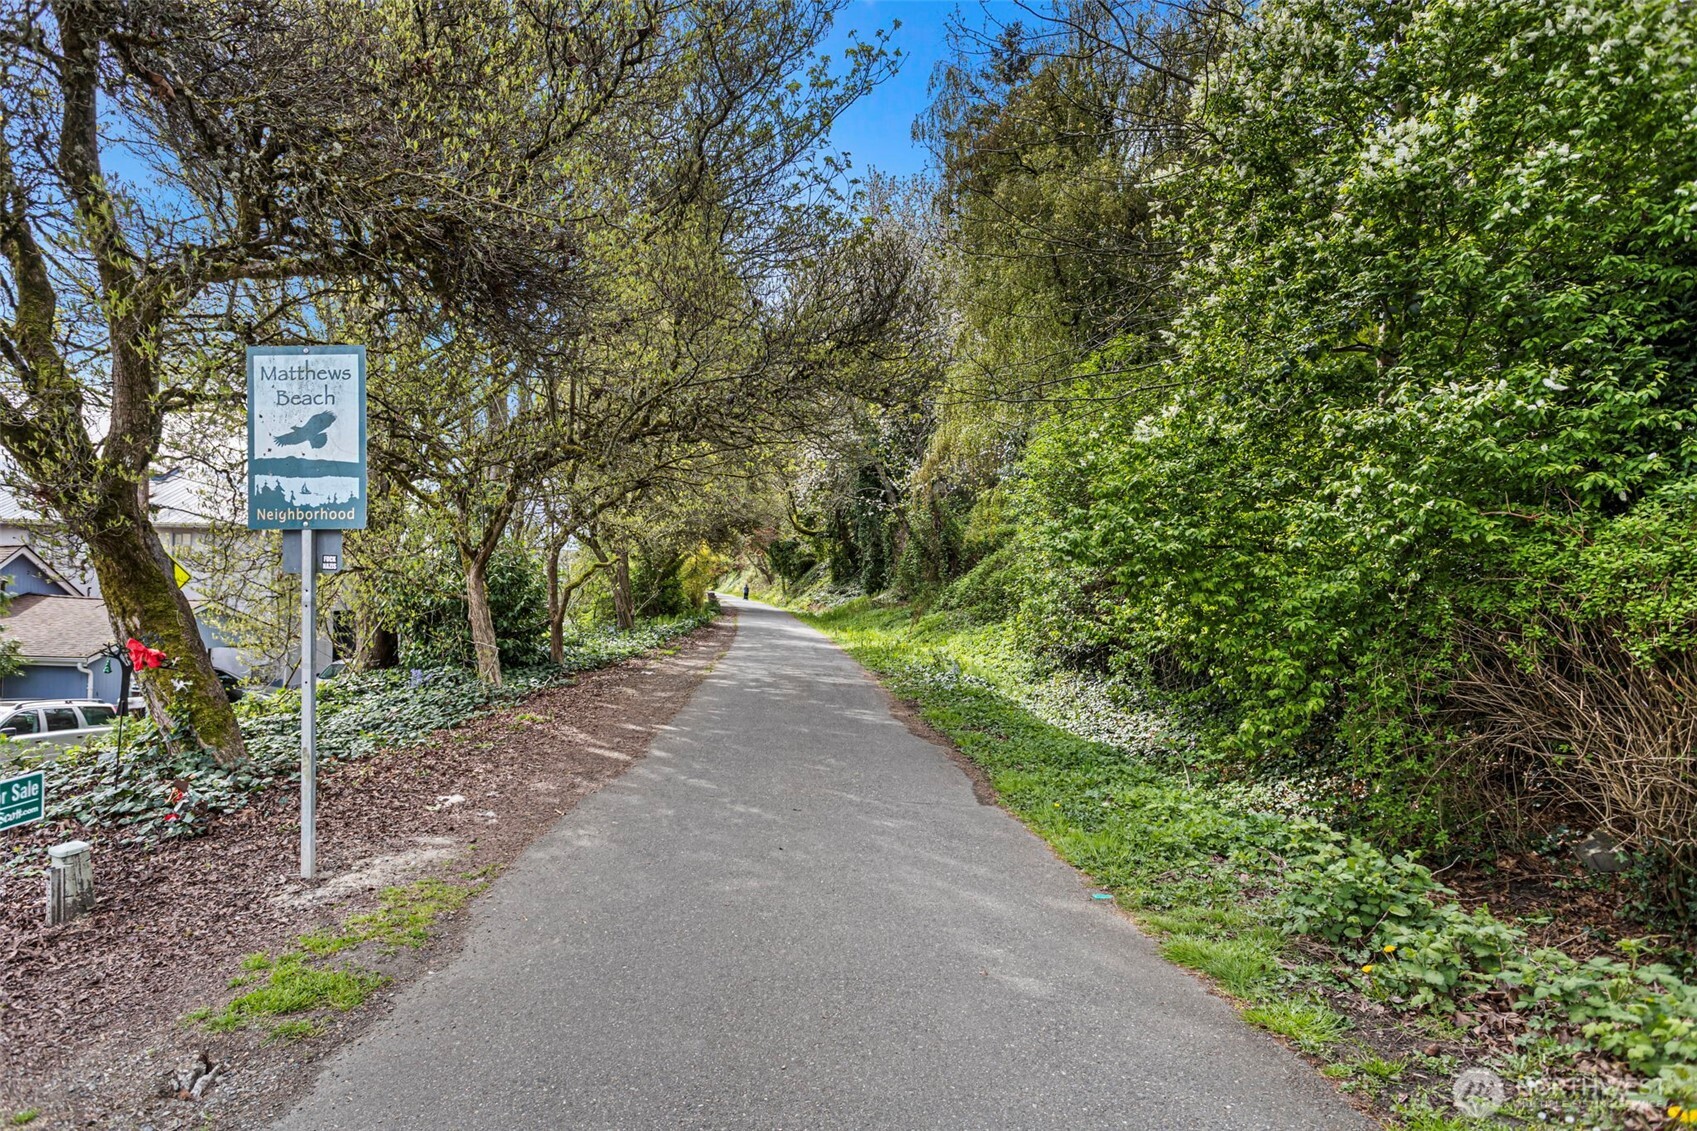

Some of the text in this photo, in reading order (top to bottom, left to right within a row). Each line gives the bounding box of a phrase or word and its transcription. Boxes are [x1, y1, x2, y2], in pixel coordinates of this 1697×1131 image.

[260, 360, 351, 381] Matthews
[276, 385, 335, 405] Beach
[256, 508, 355, 522] Neighborhood
[11, 780, 39, 801] Sale
